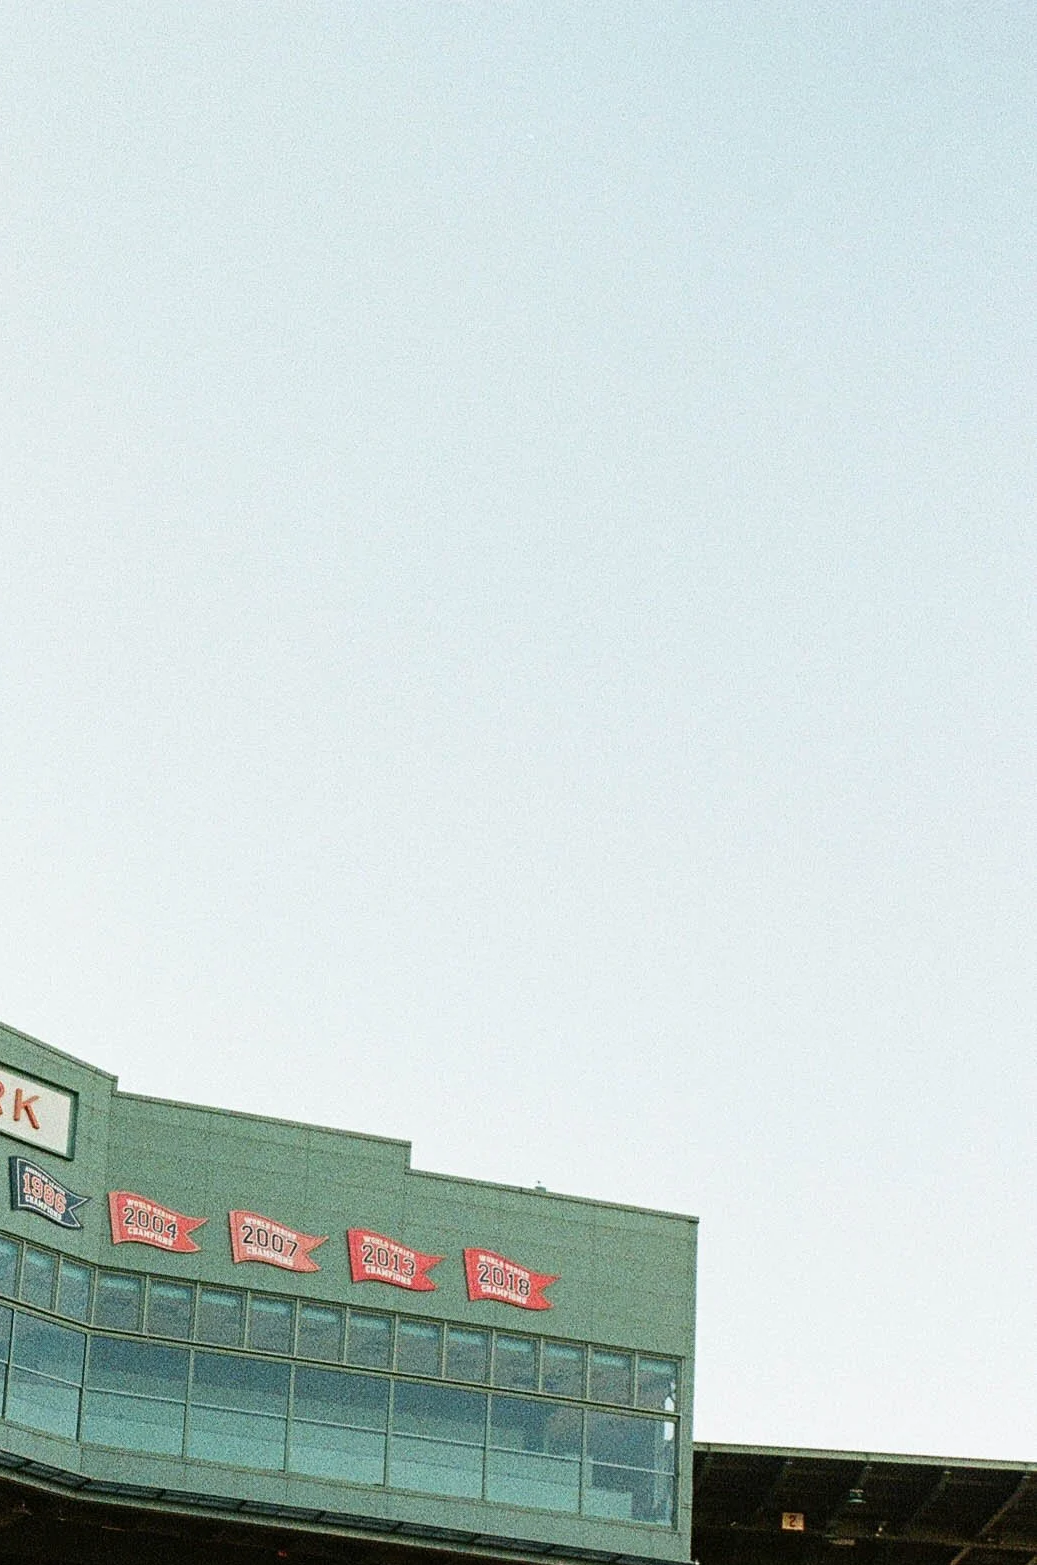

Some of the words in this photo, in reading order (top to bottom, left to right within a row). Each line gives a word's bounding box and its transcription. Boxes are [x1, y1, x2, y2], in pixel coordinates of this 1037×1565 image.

[22, 1172, 67, 1214] 1986
[24, 1194, 62, 1221] CHAMPIONS
[123, 1206, 178, 1239] 2004
[127, 1227, 173, 1247] CHAMPIONS
[241, 1224, 299, 1258] 2007
[361, 1243, 416, 1278] 2013
[364, 1265, 412, 1286] CHAMPIONS
[477, 1263, 531, 1297] 2018
